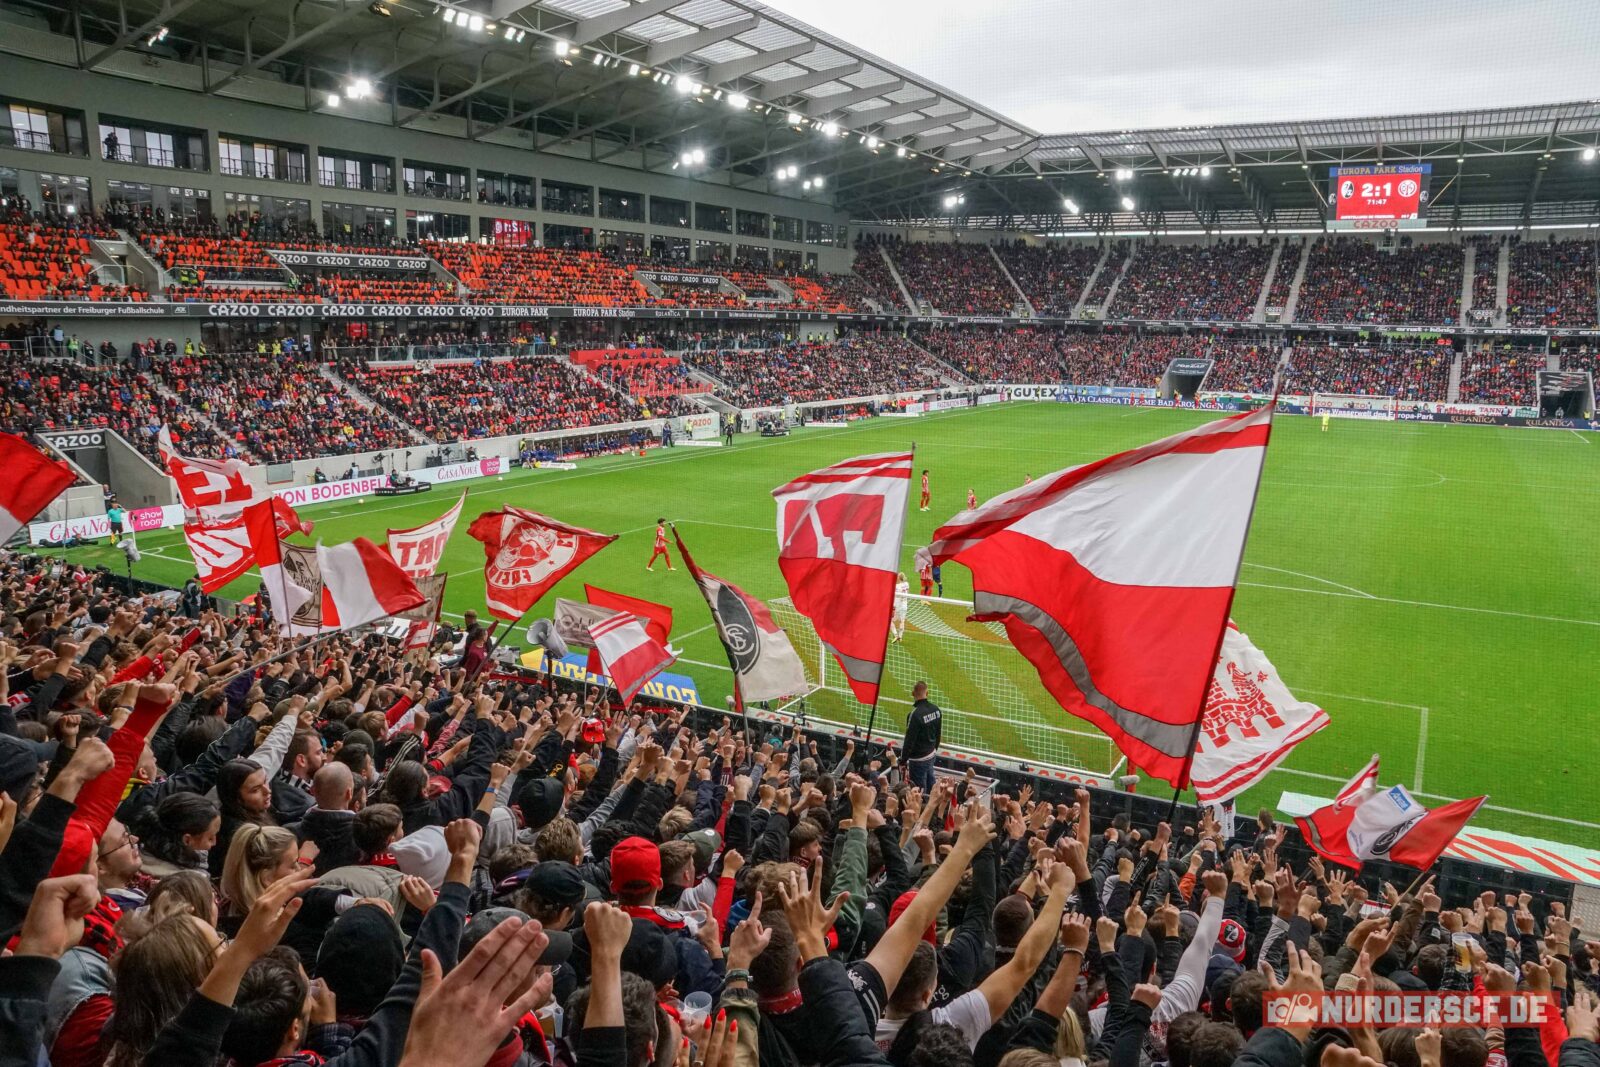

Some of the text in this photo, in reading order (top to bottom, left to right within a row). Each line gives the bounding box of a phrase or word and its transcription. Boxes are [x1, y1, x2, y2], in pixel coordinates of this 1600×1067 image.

[1338, 165, 1423, 175] EUROPA PARK Stadion
[1361, 182, 1392, 197] 2:1
[1353, 220, 1398, 229] CAZOO
[274, 254, 427, 269] AZOO CAZOO CAZOO CAZOO
[78, 306, 116, 316] Freiburger
[118, 306, 165, 314] Fußballschule
[208, 305, 495, 316] CAZOO CAZOO CAZOO CAZOO CAZOO CAZOO
[501, 307, 549, 317] EUROPA PARK
[573, 308, 600, 317] EUROPA
[601, 309, 617, 317] PARK
[1013, 387, 1057, 398] GUTEX
[1157, 399, 1174, 407] BAD
[1388, 411, 1434, 421] Eropa-Park
[1450, 416, 1497, 424] RULANTICA
[1525, 419, 1575, 427] RULANTICA
[46, 433, 102, 448] AZOO
[139, 518, 163, 528] room
